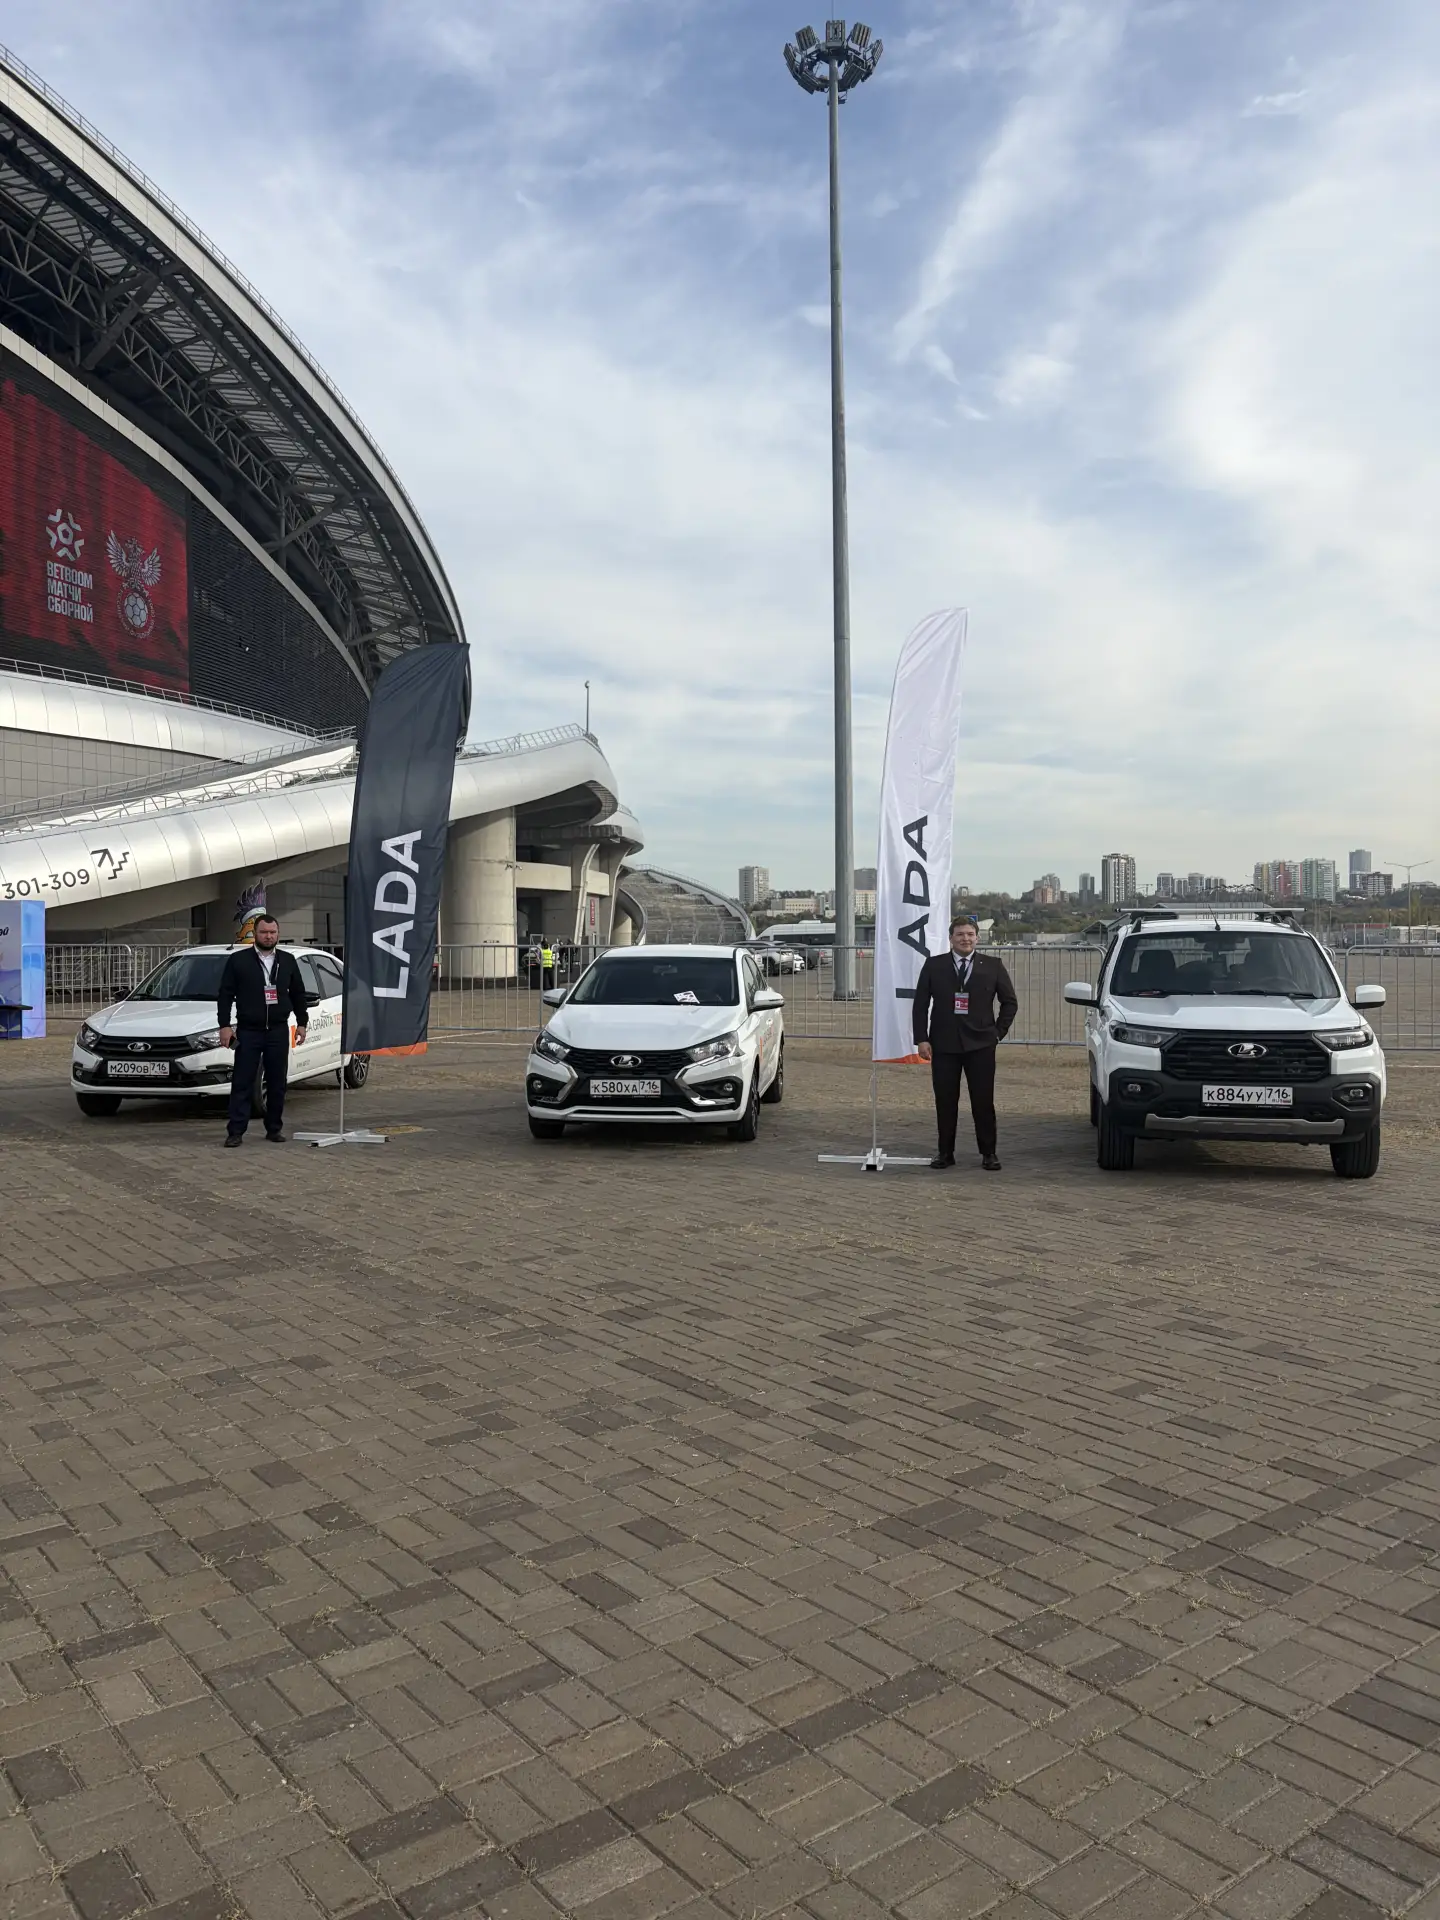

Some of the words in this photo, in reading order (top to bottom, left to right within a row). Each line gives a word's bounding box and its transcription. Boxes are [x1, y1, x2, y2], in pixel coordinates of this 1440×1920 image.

[46, 560, 93, 590] BETBOOM
[47, 577, 82, 603] МАТЧИ
[47, 595, 94, 623] СБОРНОЙ
[1, 868, 90, 900] 301-309
[373, 830, 422, 998] LADA
[312, 1015, 333, 1031] GRANTA
[150, 1062, 167, 1071] 716
[640, 1081, 658, 1090] 716
[1266, 1088, 1289, 1099] 716
